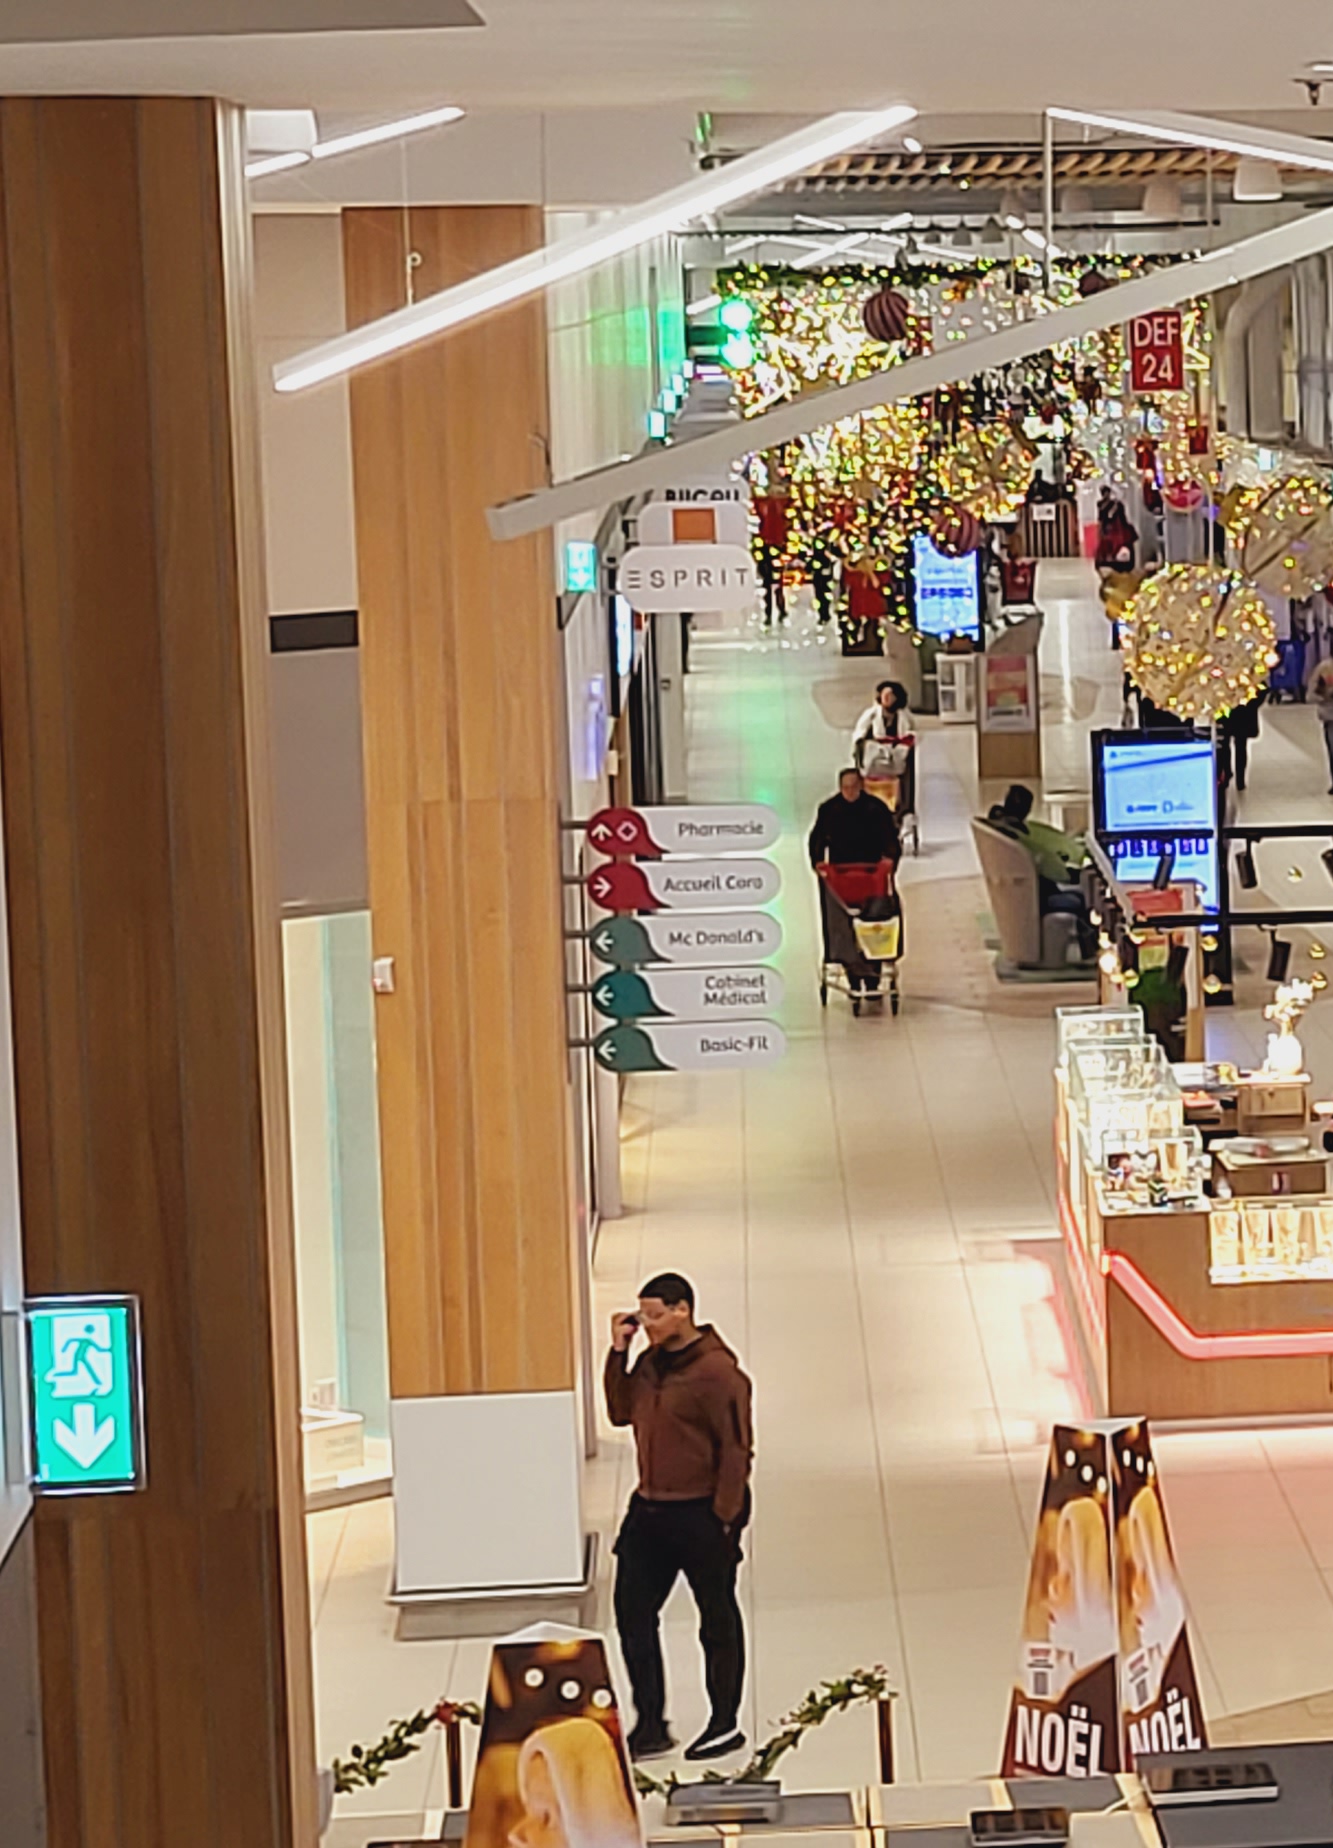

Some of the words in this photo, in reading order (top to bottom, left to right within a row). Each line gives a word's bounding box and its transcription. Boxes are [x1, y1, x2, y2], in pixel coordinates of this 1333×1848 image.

[1133, 316, 1179, 347] DEF
[1141, 352, 1174, 383] 24
[627, 568, 748, 589] ESPRIT
[678, 821, 764, 838] Pharmacie
[663, 874, 722, 892] Accueil
[725, 874, 764, 891] Cora
[669, 932, 692, 946] Mc
[696, 929, 765, 945] Donald's
[705, 973, 766, 990] Cabinet
[703, 989, 767, 1006] Médical
[700, 1036, 769, 1053] Basic-Fit
[1127, 1686, 1202, 1755] NOËL
[1014, 1704, 1110, 1779] NOËL
